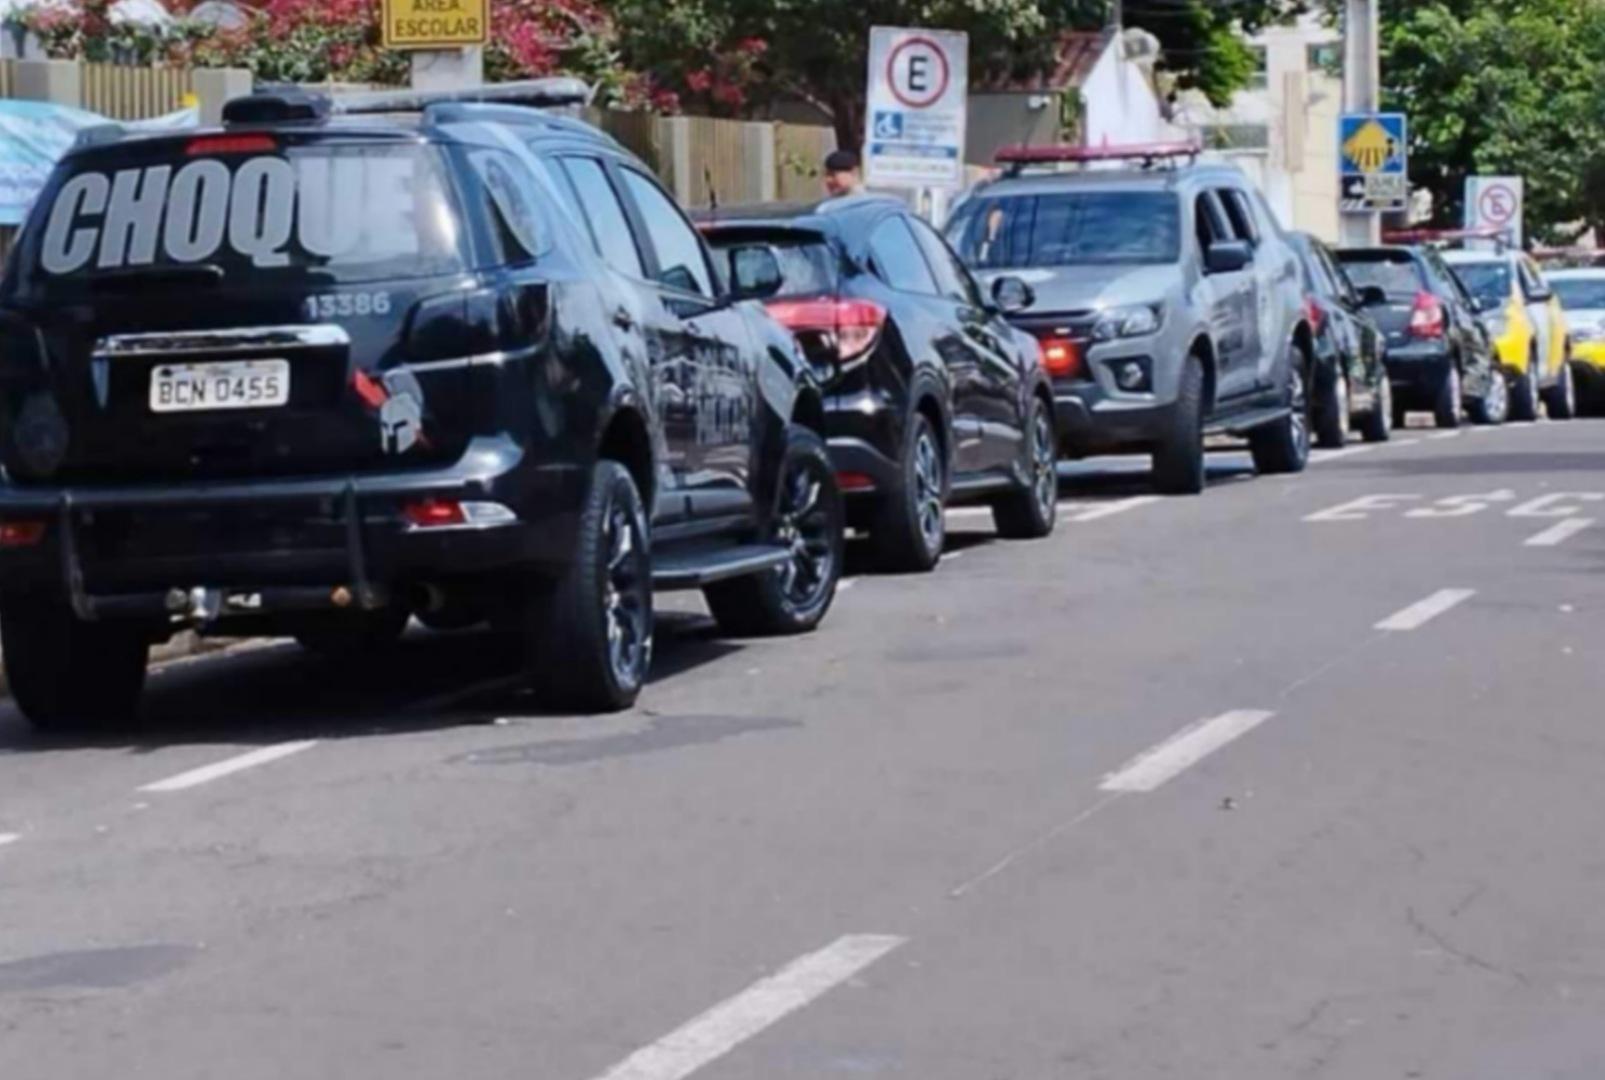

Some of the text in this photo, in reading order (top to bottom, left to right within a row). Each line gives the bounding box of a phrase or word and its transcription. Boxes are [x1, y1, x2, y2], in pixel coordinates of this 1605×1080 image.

[395, 17, 478, 37] ESCOLAR
[908, 55, 928, 92] E
[41, 156, 419, 275] CHOQUE
[306, 291, 390, 318] 13386
[159, 376, 279, 404] BCN 0455
